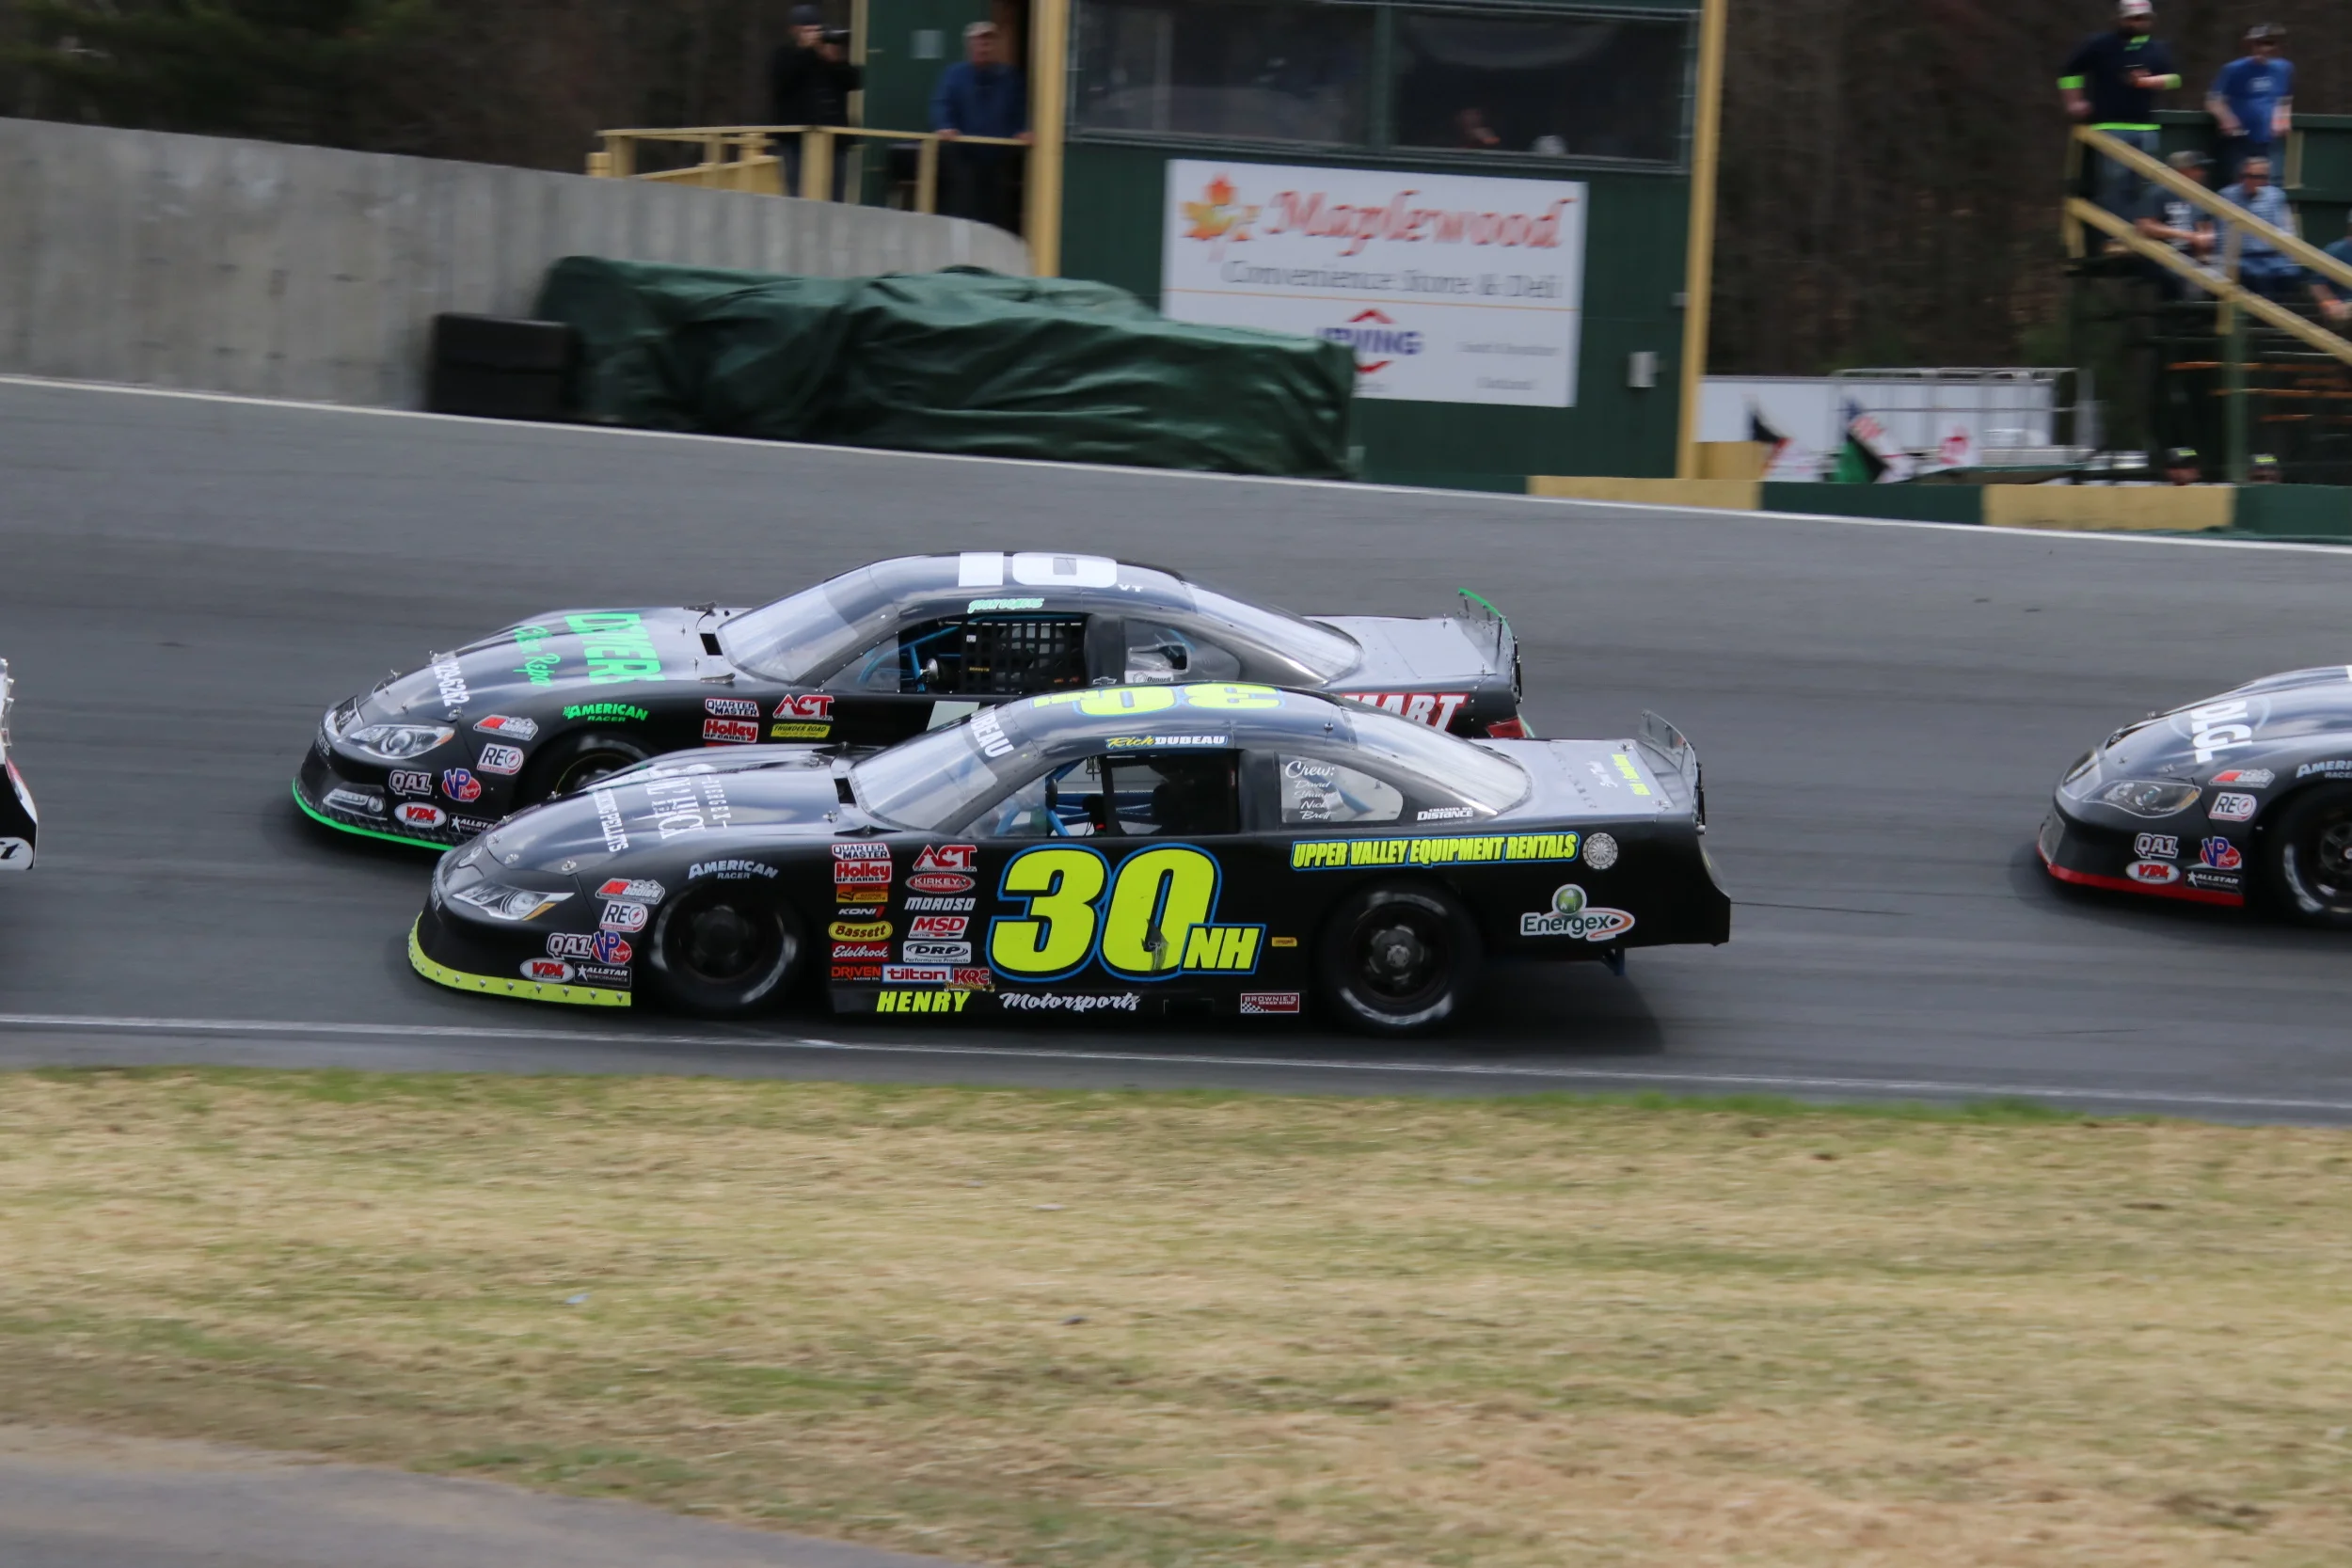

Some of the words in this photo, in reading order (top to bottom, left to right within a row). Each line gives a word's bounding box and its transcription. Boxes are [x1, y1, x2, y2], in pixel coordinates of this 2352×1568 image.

[1264, 189, 1577, 256] Maplewood
[564, 704, 649, 721] AMERICAN
[706, 701, 755, 710] QUARTER
[715, 707, 757, 716] MASTER
[706, 721, 757, 742] Holley
[1154, 736, 1226, 745] DUBEAU
[1285, 760, 1335, 779] Crew:
[391, 771, 430, 793] QA1
[445, 768, 470, 800] VP
[833, 845, 884, 855] QUARTER
[1292, 841, 1347, 868] UPPER
[1349, 840, 1408, 865] VALLEY
[1408, 837, 1505, 865] EQUIPMENT
[1505, 833, 1578, 860] RENTALS
[2137, 836, 2176, 854] QA1
[2202, 837, 2229, 867] VP
[842, 851, 888, 860] MASTER
[688, 860, 779, 880] AMERICAN
[835, 862, 890, 881] Holley
[914, 877, 960, 885] KIRKEY
[904, 896, 977, 911] MOROSO
[991, 847, 1215, 973] 30
[834, 925, 886, 939] Bassett
[913, 917, 966, 932] MSD
[1523, 915, 1611, 935] Energex
[549, 936, 589, 956] QA1
[595, 931, 620, 963] VP
[832, 945, 888, 958] Edelbrock
[914, 946, 960, 955] DRP
[1184, 927, 1260, 970] NH
[587, 966, 628, 976] ALLSTAR
[832, 966, 881, 978] DRIVEN
[887, 968, 946, 980] tilton
[953, 968, 990, 985] KRC
[876, 991, 970, 1012] HENRY
[999, 991, 1140, 1012] Motorsports
